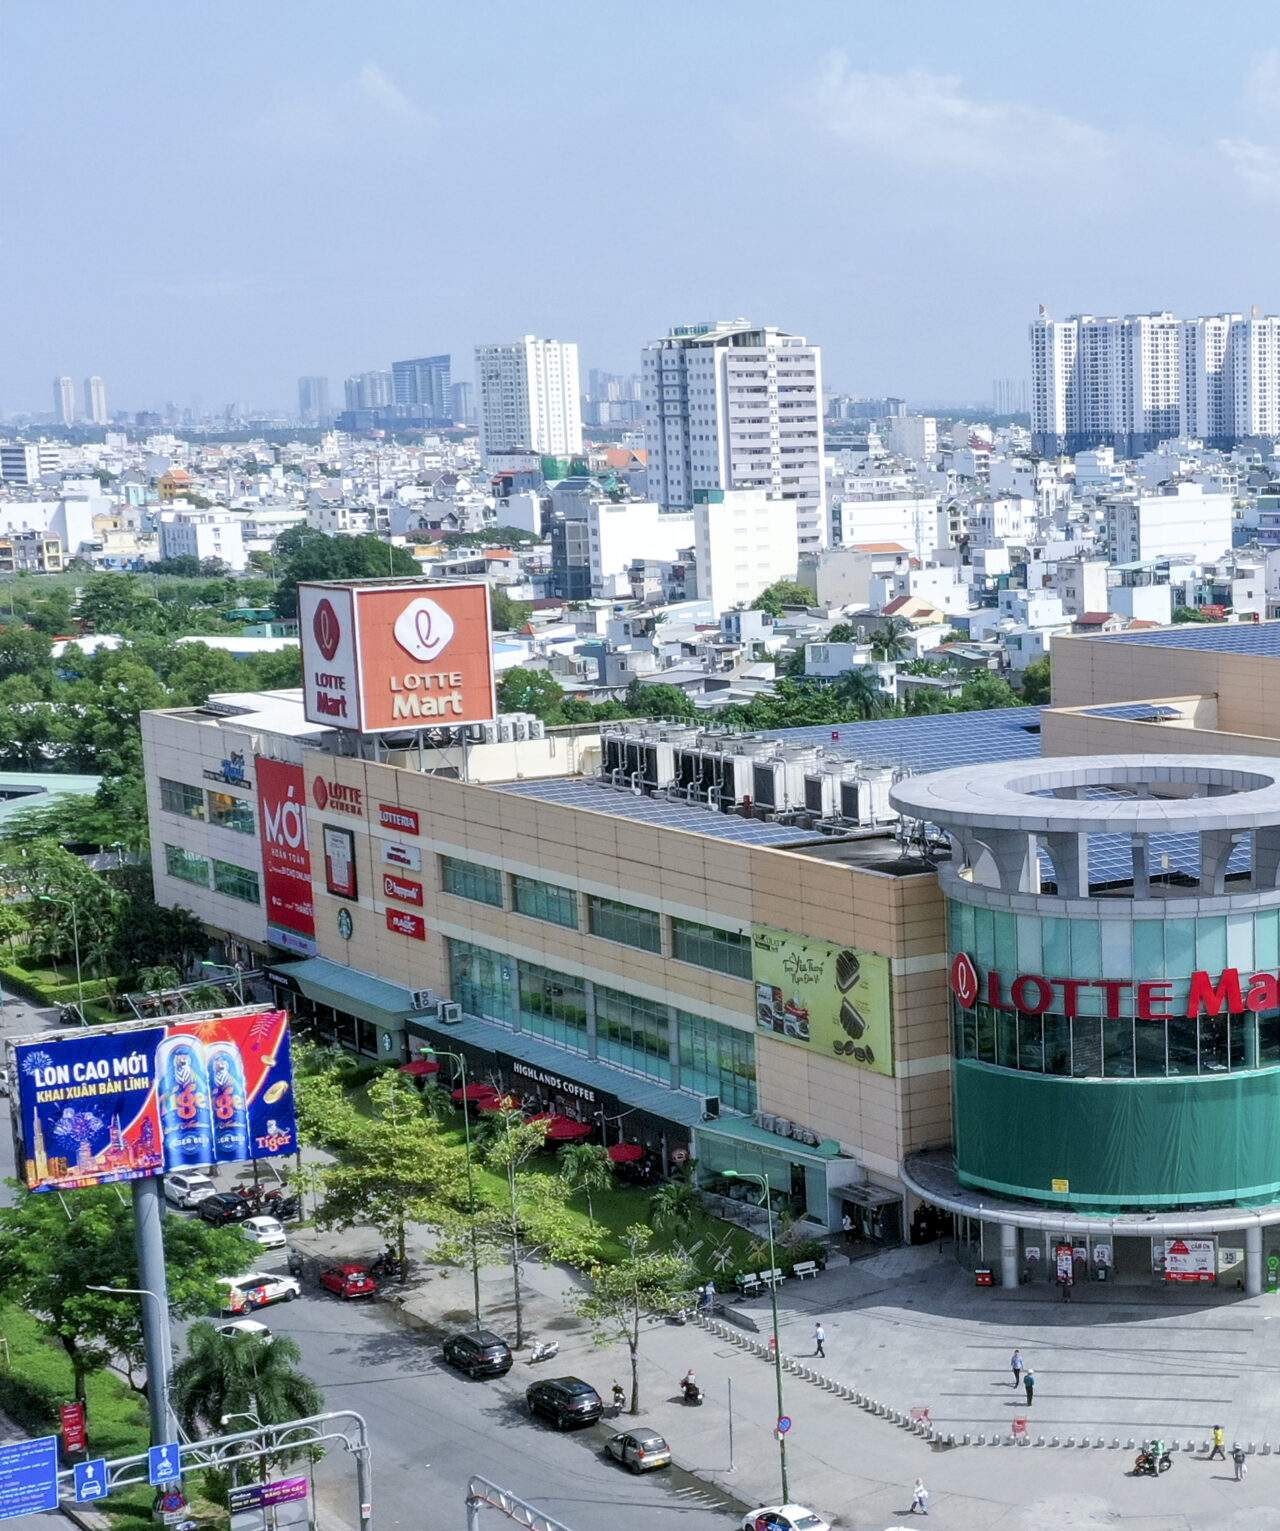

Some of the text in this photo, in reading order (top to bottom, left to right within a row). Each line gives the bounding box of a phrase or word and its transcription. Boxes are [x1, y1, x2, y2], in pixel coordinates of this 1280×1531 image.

[315, 672, 346, 691] LOTTE
[390, 670, 462, 692] LOTTE
[317, 691, 347, 718] Mart
[392, 692, 463, 719] Mart
[328, 782, 362, 805] LOTTE
[330, 801, 363, 817] CINEMA
[987, 968, 1173, 1021] LOTTE
[35, 1051, 148, 1088] LON CAO MỚI
[513, 1061, 595, 1102] HIGHLANDS COFFEE
[37, 1087, 64, 1104] KHAI
[65, 1083, 97, 1099] XUÂN
[123, 1076, 149, 1093] LĨNH
[256, 1134, 292, 1152] Tiger
